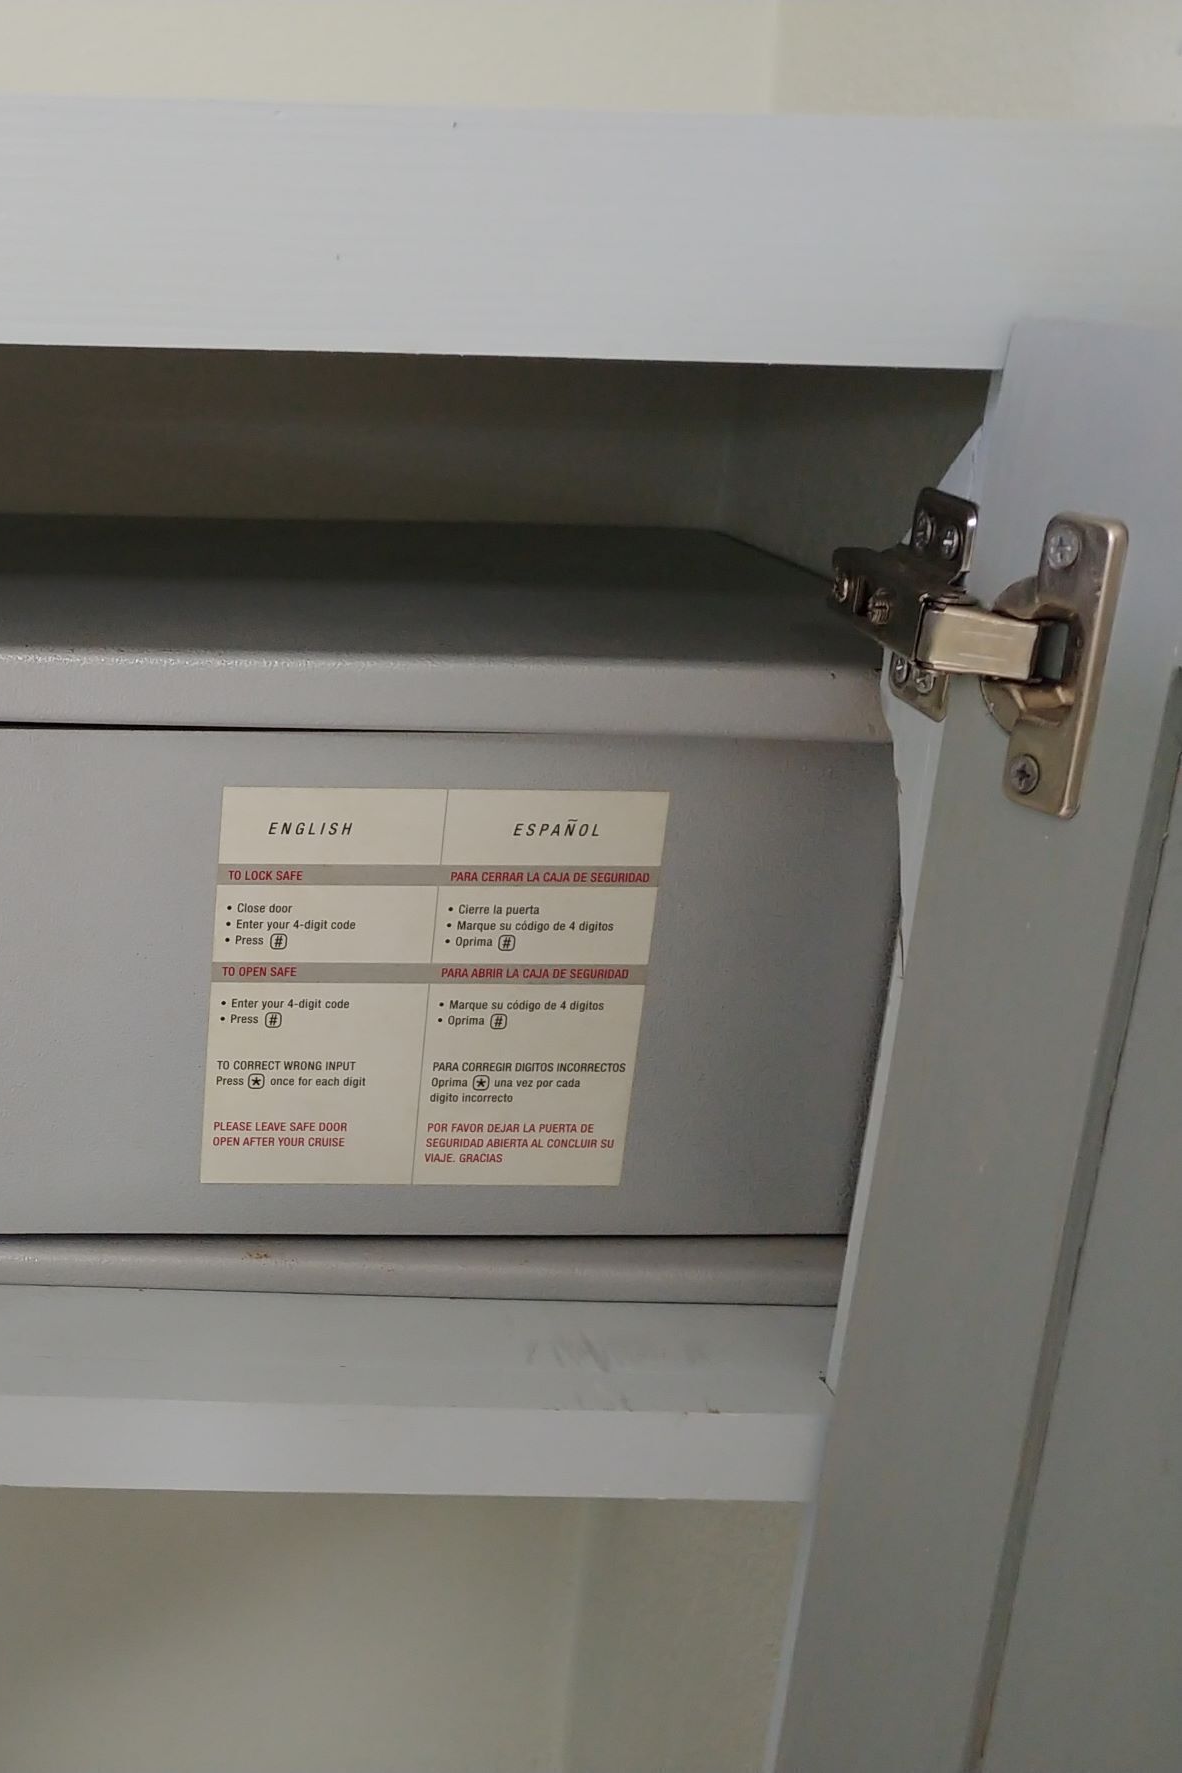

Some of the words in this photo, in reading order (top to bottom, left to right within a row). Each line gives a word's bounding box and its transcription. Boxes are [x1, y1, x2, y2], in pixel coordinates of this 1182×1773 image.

[268, 822, 353, 835] ENGLISH
[513, 819, 600, 837] ESPAÑOL
[228, 870, 241, 881] TO
[245, 870, 273, 881] LOCK
[276, 870, 303, 881] SAFE
[450, 872, 478, 882] PARA
[481, 872, 524, 882] CERRAR
[527, 872, 540, 882] LA
[543, 872, 569, 883] CAJA
[573, 873, 587, 883] DE
[590, 873, 650, 883] SEGURIDAD
[237, 903, 266, 914] Close
[269, 904, 293, 914] door
[458, 904, 490, 915] Cierre
[493, 904, 503, 915] la
[506, 905, 540, 916] puerta
[236, 920, 263, 930] Enter
[267, 921, 290, 931] your
[293, 920, 327, 931] 4-digit
[331, 920, 356, 930] code
[457, 921, 496, 932] Marque
[500, 923, 512, 931] su
[515, 921, 550, 933] código
[553, 921, 566, 931] de
[569, 922, 575, 931] 4
[235, 936, 264, 945] Press
[455, 937, 493, 948] Oprima
[222, 967, 235, 976] TO
[239, 967, 267, 977] OPEN
[270, 967, 297, 977] SAFE
[441, 968, 468, 977] PARA
[471, 968, 503, 978] ABRIR
[506, 969, 519, 978] LA
[522, 969, 549, 979] CAJA
[553, 969, 566, 979] DE
[570, 969, 629, 979] SEGURIDAD
[231, 999, 258, 1009] Enter
[261, 1001, 284, 1010] your
[287, 999, 322, 1010] 4-digit
[325, 999, 350, 1009] code
[449, 1000, 488, 1011] Marque
[491, 1002, 503, 1010] su
[507, 1000, 541, 1012] código
[544, 1000, 556, 1010] de
[560, 1001, 566, 1010] 4
[230, 1014, 258, 1024] Press
[448, 1016, 484, 1027] Oprima
[217, 1061, 229, 1070] TO
[233, 1061, 281, 1070] CORRECT
[284, 1061, 322, 1071] WRONG
[325, 1061, 356, 1071] INPUT
[433, 1062, 459, 1071] PARA
[462, 1062, 512, 1072] CORREGIR
[515, 1063, 554, 1072] DIGITOS
[557, 1063, 626, 1073] INCORRECTOS
[216, 1076, 244, 1086] Press
[270, 1078, 294, 1086] once
[298, 1077, 312, 1086] for
[316, 1077, 340, 1086] each
[343, 1077, 366, 1088] digit
[431, 1078, 467, 1089] Oprima
[494, 1080, 513, 1088] una
[517, 1080, 533, 1088] vez
[536, 1080, 553, 1089] por
[556, 1079, 580, 1088] cada
[462, 1093, 513, 1103] incorrecto
[214, 1122, 252, 1132] PLEASE
[255, 1122, 286, 1132] LEAVE
[290, 1122, 315, 1132] SAFE
[319, 1122, 347, 1132] DOOR
[427, 1123, 447, 1133] POR
[451, 1123, 483, 1133] FAVOR
[487, 1124, 519, 1134] DEJAR
[523, 1124, 536, 1133] LA
[539, 1124, 577, 1133] PUERTA
[580, 1124, 594, 1133] DE
[213, 1137, 240, 1146] OPEN
[243, 1137, 275, 1146] AFTER
[278, 1138, 305, 1147] YOUR
[308, 1138, 345, 1147] CRUISE
[426, 1138, 484, 1148] SEGURIDAD
[487, 1139, 528, 1148] ABIERTA
[531, 1139, 544, 1148] AL
[547, 1139, 597, 1148] CONCLUIR
[601, 1139, 614, 1148] SU
[425, 1154, 456, 1163] VIAJE.
[459, 1154, 503, 1163] GRACIAS
